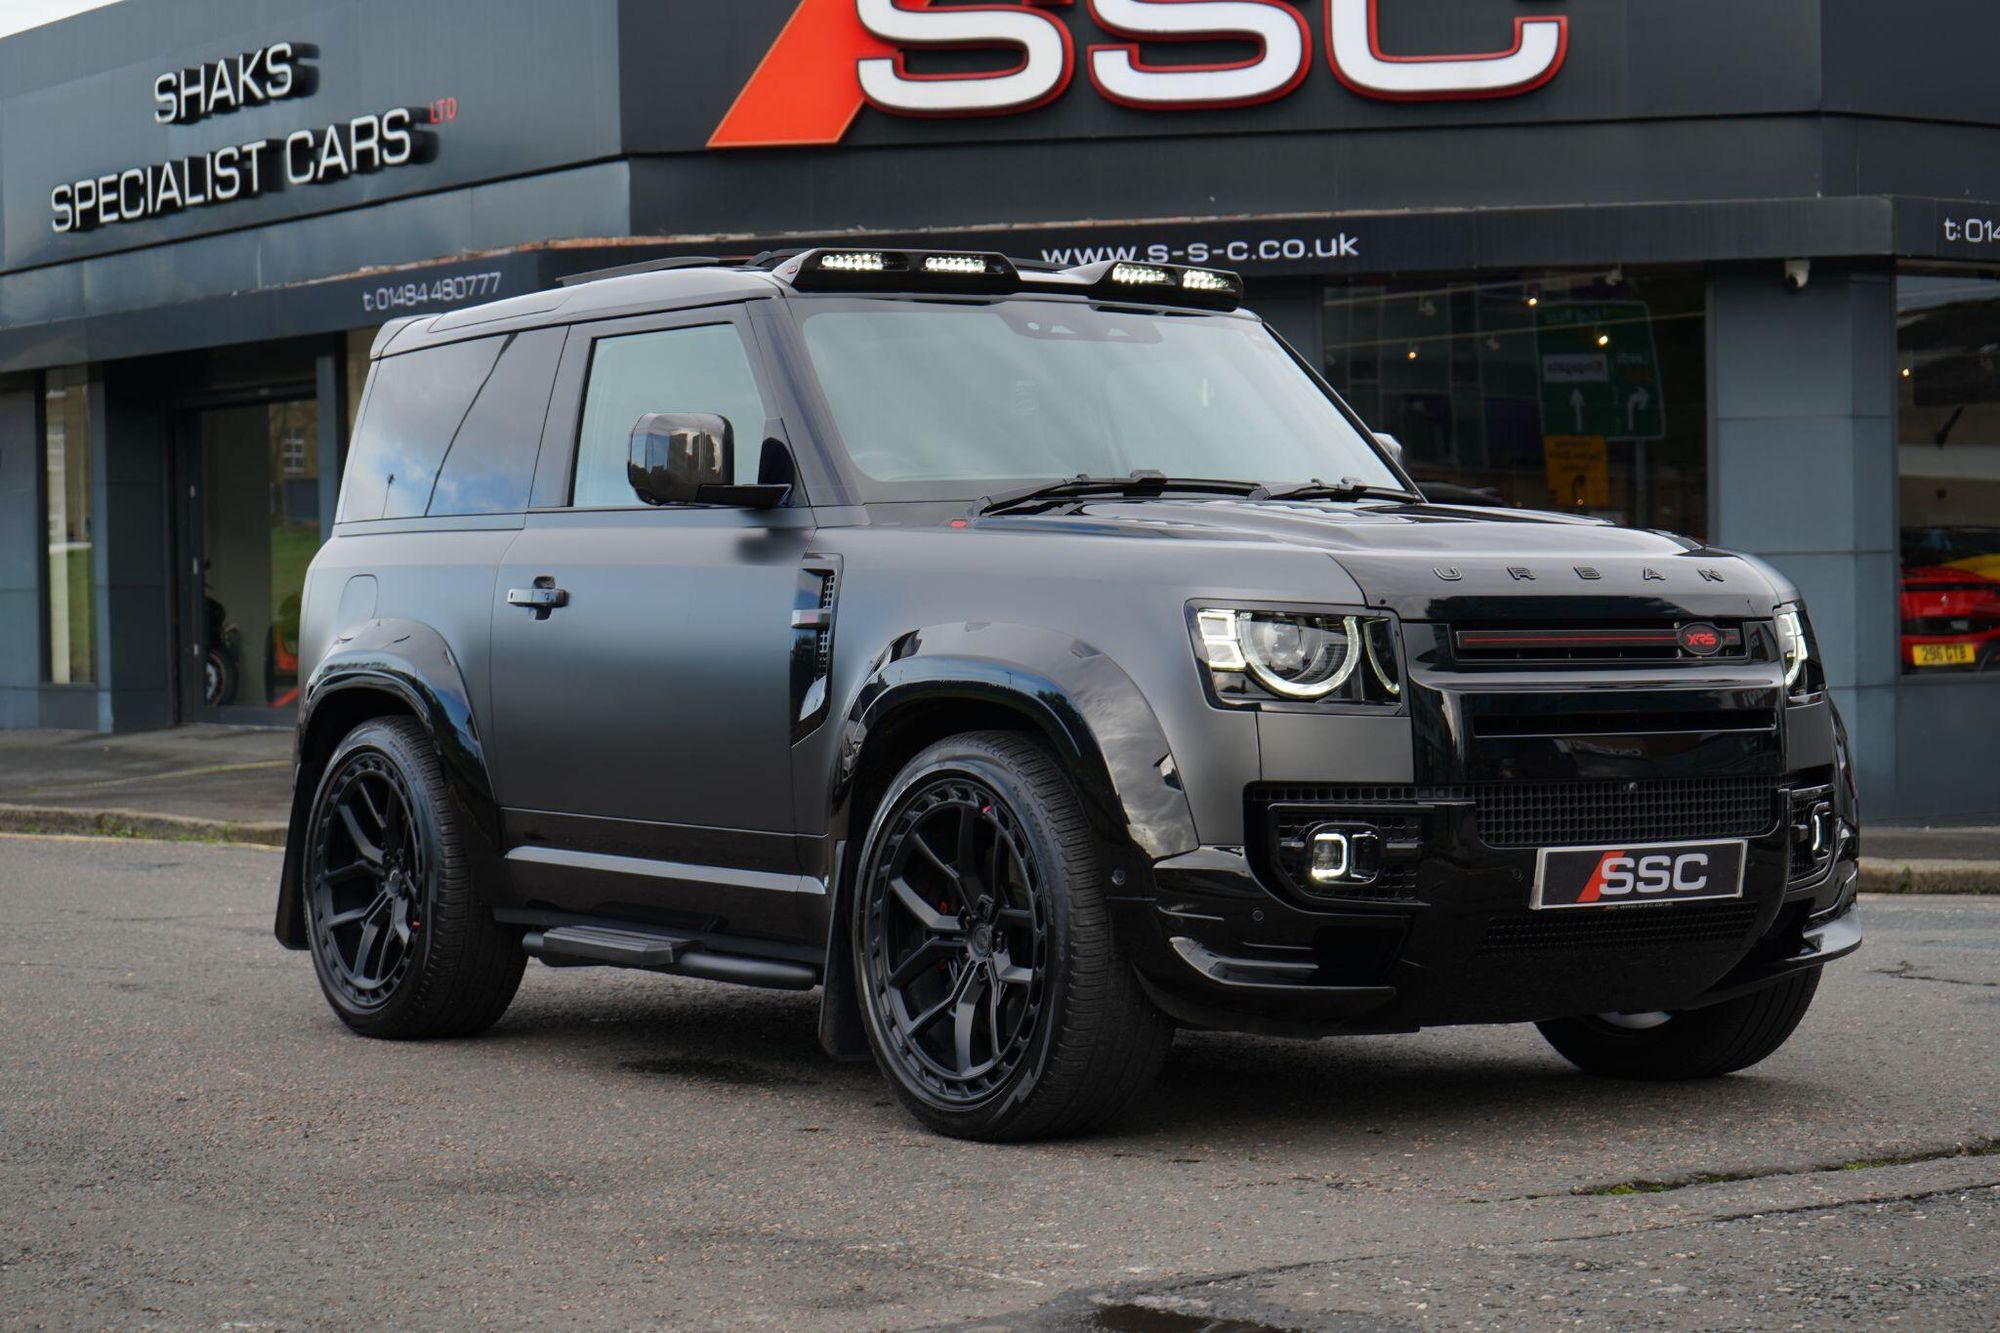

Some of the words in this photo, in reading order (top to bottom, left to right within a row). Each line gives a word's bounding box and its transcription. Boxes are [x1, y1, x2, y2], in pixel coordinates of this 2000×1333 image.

[154, 42, 293, 125] SHAKS
[429, 97, 458, 125] LTD
[51, 139, 267, 233] SPECIALIST
[285, 107, 412, 185] CARS
[1040, 232, 1360, 265] www.s-s-c.co.uk
[430, 271, 502, 301] 480777
[1432, 566, 1725, 582] URBAN
[1686, 632, 1717, 646] XRS
[1599, 853, 1709, 896] SSC
